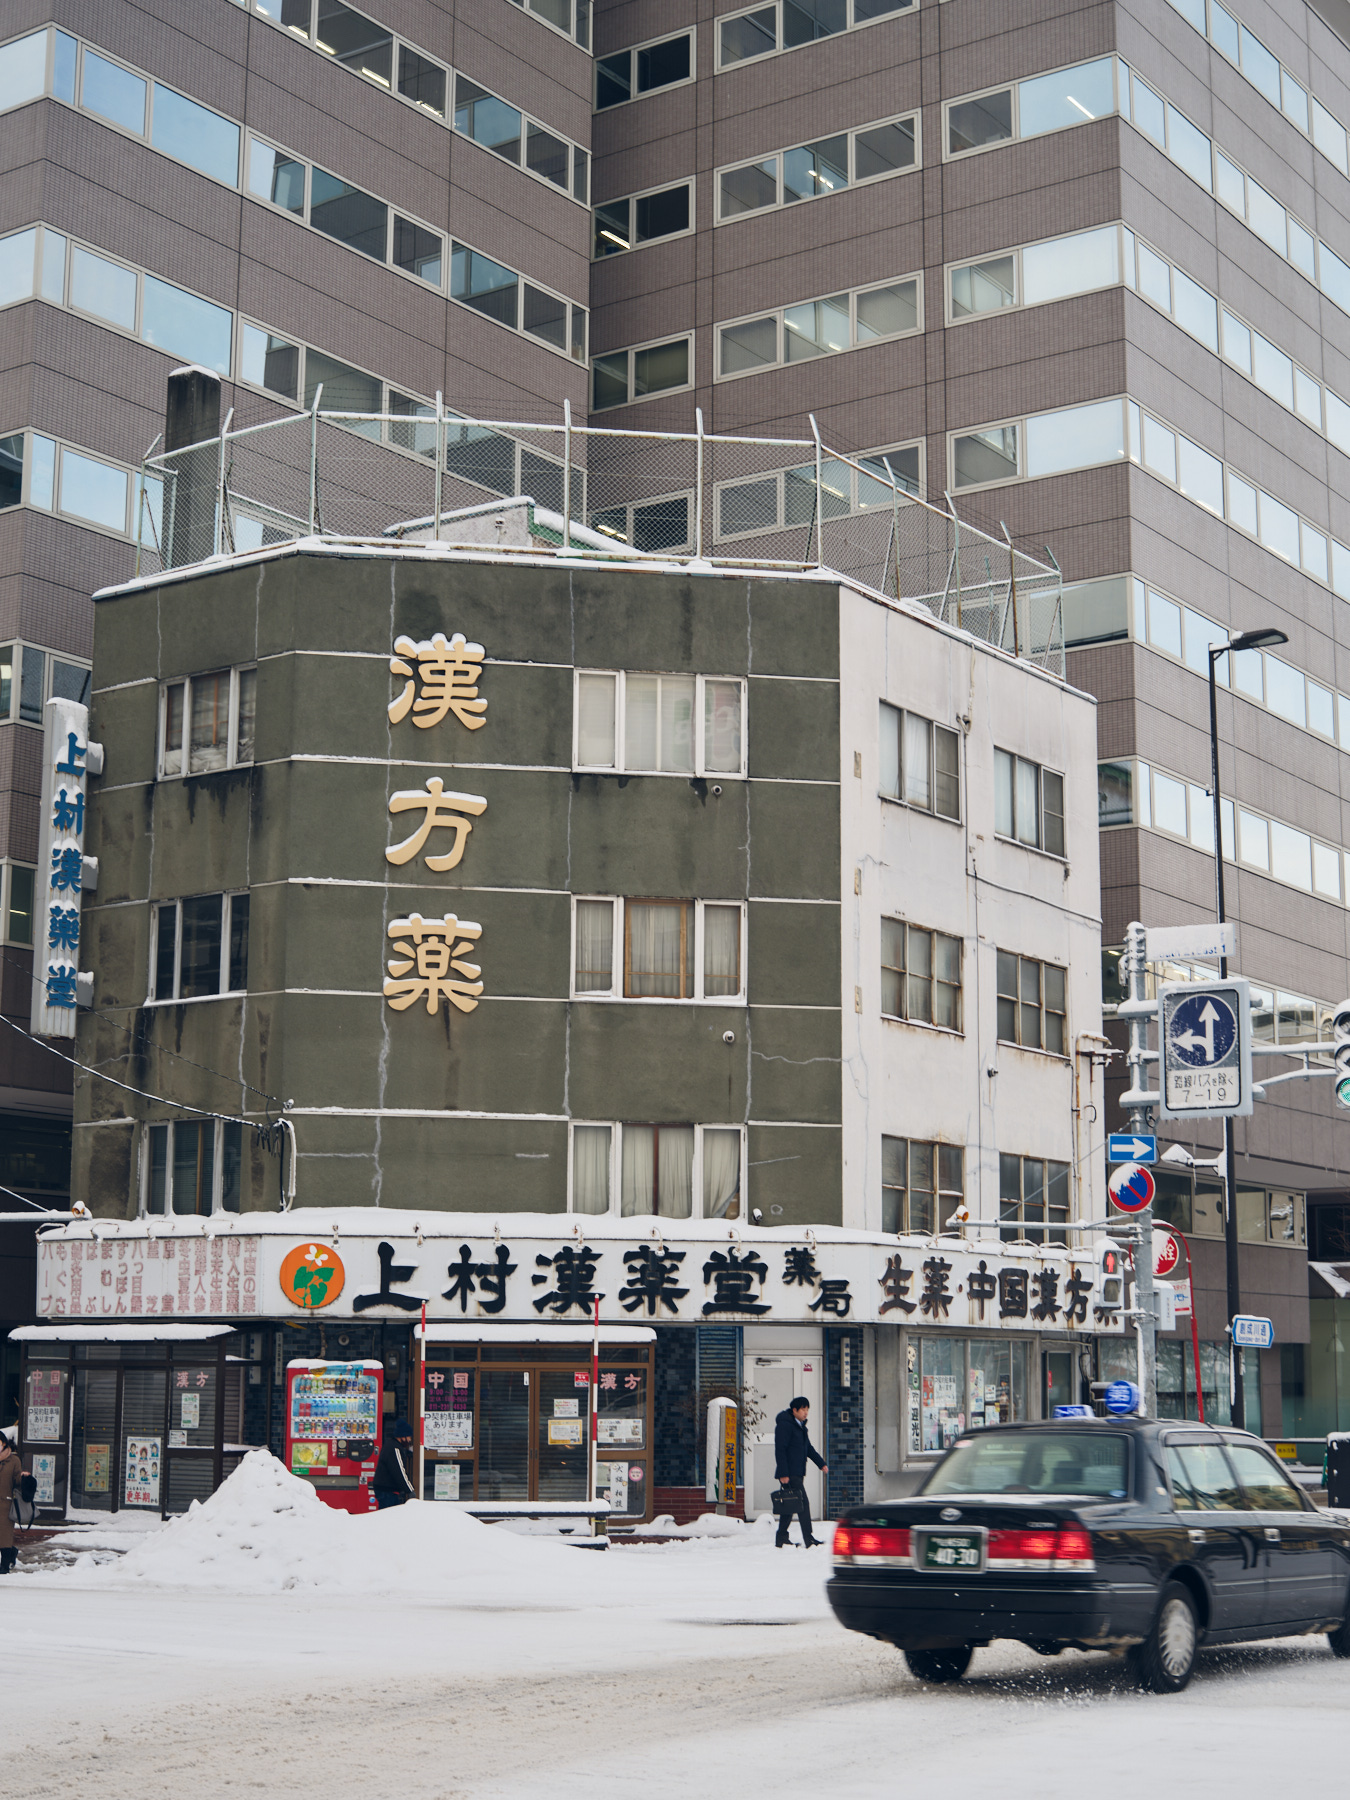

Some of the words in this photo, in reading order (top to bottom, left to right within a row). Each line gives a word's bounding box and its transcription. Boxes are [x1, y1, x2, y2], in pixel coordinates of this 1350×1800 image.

[384, 634, 488, 1015] 漢方薬
[1174, 1073, 1233, 1089] 路線バスを除く
[41, 1244, 53, 1314] ハーブ
[56, 1243, 67, 1314] もぐさ
[85, 1242, 97, 1314] はぶ
[101, 1241, 113, 1314] まむし
[115, 1241, 128, 1314] すっぽん
[353, 1241, 773, 1316] 上村漢薬堂
[782, 1247, 853, 1317] 薬局
[32, 1369, 61, 1386] 中国
[176, 1371, 209, 1388] 漢方
[428, 1371, 469, 1389] 中国
[600, 1373, 642, 1390] 漢方
[34, 1415, 55, 1423] あります
[433, 1421, 463, 1429] あります
[724, 1443, 735, 1501] 冠元顆粒
